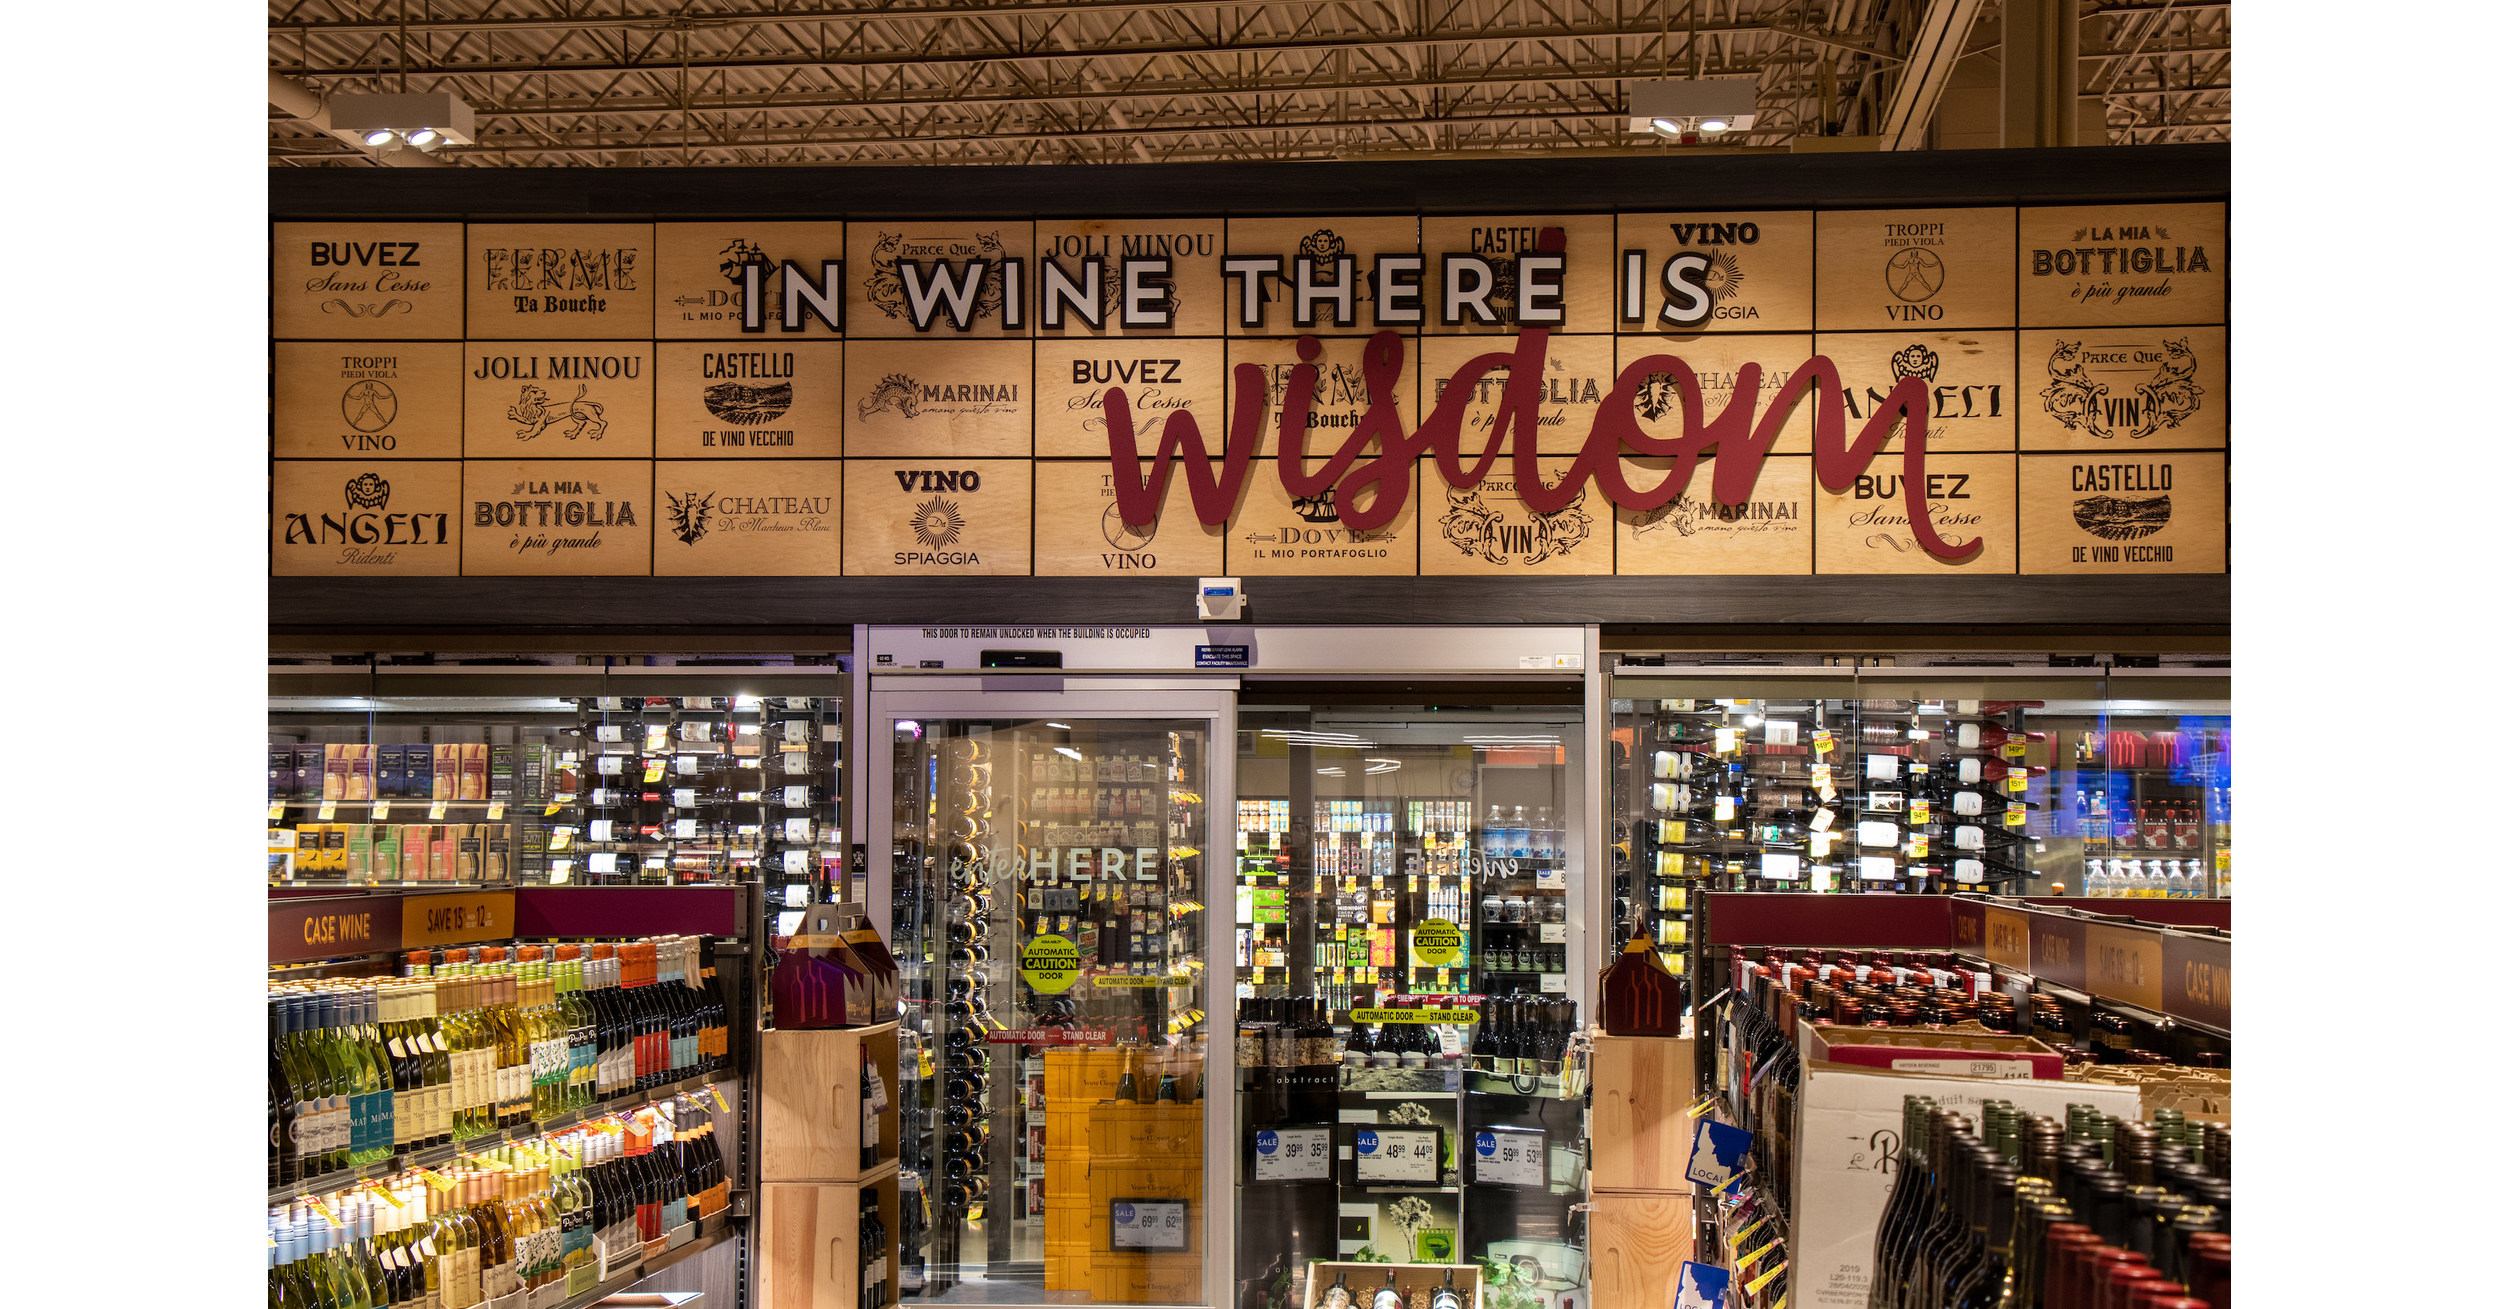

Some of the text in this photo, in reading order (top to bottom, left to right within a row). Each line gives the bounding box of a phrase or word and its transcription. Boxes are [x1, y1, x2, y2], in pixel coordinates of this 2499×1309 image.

[1669, 222, 1760, 245] VINO
[1884, 223, 1945, 237] TROPPI
[2091, 225, 2151, 241] LA MIA
[1046, 234, 1215, 258] JOLI MINOU
[1472, 227, 1564, 253] CASTEL
[1884, 238, 1945, 247] PIEDI VIOLA
[311, 242, 421, 266] BUVEZ
[2032, 246, 2212, 277] BOTTIGLIA
[484, 248, 638, 291] FERME
[305, 269, 431, 294] Sans Cesse
[742, 259, 845, 333] IN
[898, 256, 1173, 332] WINE
[1221, 252, 1567, 329] THERE
[1622, 249, 1714, 328] IS
[2081, 281, 2113, 304] più
[2114, 278, 2173, 306] grande
[513, 294, 607, 315] Ta Bouche
[1711, 305, 1760, 320] GGIA
[1885, 304, 1944, 321] VINO
[682, 312, 723, 321] IL MIO
[341, 356, 398, 369] TROPPI
[473, 355, 641, 380] JOLI MINOU
[703, 353, 794, 378] CASTELLO
[1072, 359, 1182, 384] BUVEZ
[340, 370, 398, 379] PIEDI VIOLA
[922, 384, 1018, 402] MARINAI
[1102, 226, 1984, 561] wisdom
[1137, 387, 1193, 410] Cesse
[1305, 410, 1364, 429] Bouch
[2104, 398, 2140, 428] VIN
[341, 435, 397, 451] VINO
[703, 430, 794, 447] DE VINO VECCHIO
[895, 470, 981, 493] VINO
[1855, 474, 1970, 499] BUEZ
[2073, 465, 2172, 492] CASTELLO
[529, 481, 584, 495] LA MIA
[474, 501, 638, 528] BOTTIGLIA
[718, 497, 831, 514] CHATEAU
[1698, 502, 1798, 520] MARINAI
[284, 513, 448, 545] ANGELI
[718, 516, 740, 532] De
[517, 533, 548, 555] più
[547, 531, 603, 556] grande
[1499, 525, 1533, 554] VIN
[336, 548, 398, 566] Ridenti
[894, 552, 980, 565] SPIAGGIA
[1101, 553, 1157, 570] VINO
[1254, 549, 1388, 559] IL MIO PORTAFOGLIO
[2073, 546, 2173, 563] DE VINO VECCHIO
[922, 628, 1151, 639] THIS DOOR TO REMAIN UNLOCKED WHEN THE BUILDING IS OCCUPIED
[1030, 847, 1158, 881] HERE
[427, 907, 451, 934] SAVE
[476, 905, 485, 928] 12
[304, 912, 371, 945] CASE WINE
[1416, 937, 1458, 946] CAUTION
[1025, 958, 1077, 970] CAUTION
[1039, 972, 1063, 980] DOOR
[2186, 960, 2231, 1011] CASE WIN
[1356, 1011, 1474, 1021] AUTOMATIC DOOR STAND CLEAR
[989, 1031, 1106, 1040] AUTOMATIC DOOR STAND CLEAR
[1972, 1063, 1994, 1072] 21795
[1276, 1074, 1335, 1085] abstract
[350, 1117, 367, 1127] MAT
[1477, 1140, 1495, 1148] SALE
[1692, 1167, 1724, 1184] LOCAL
[1840, 1264, 1860, 1273] 2019
